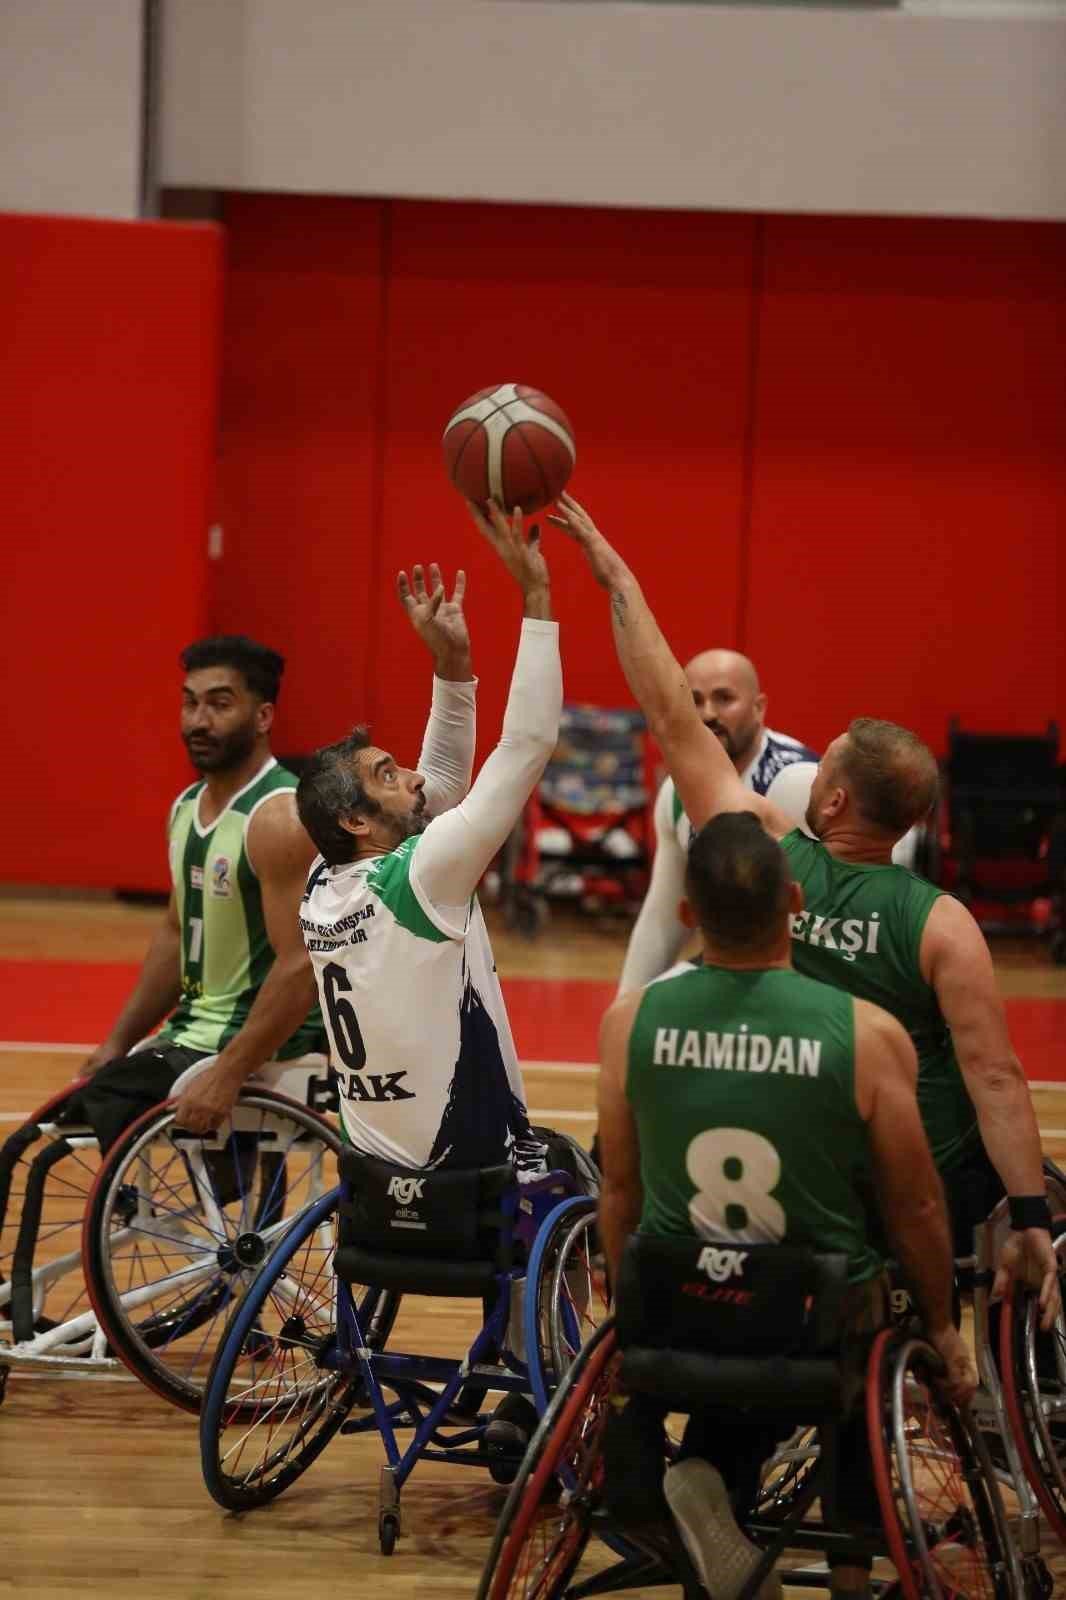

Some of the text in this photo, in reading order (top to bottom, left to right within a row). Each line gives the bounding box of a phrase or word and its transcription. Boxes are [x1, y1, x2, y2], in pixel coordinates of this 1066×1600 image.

[789, 912, 880, 961] EKŞİ
[323, 961, 367, 1070] 6
[653, 1023, 821, 1077] HAMİDAN
[686, 1127, 786, 1244] 8
